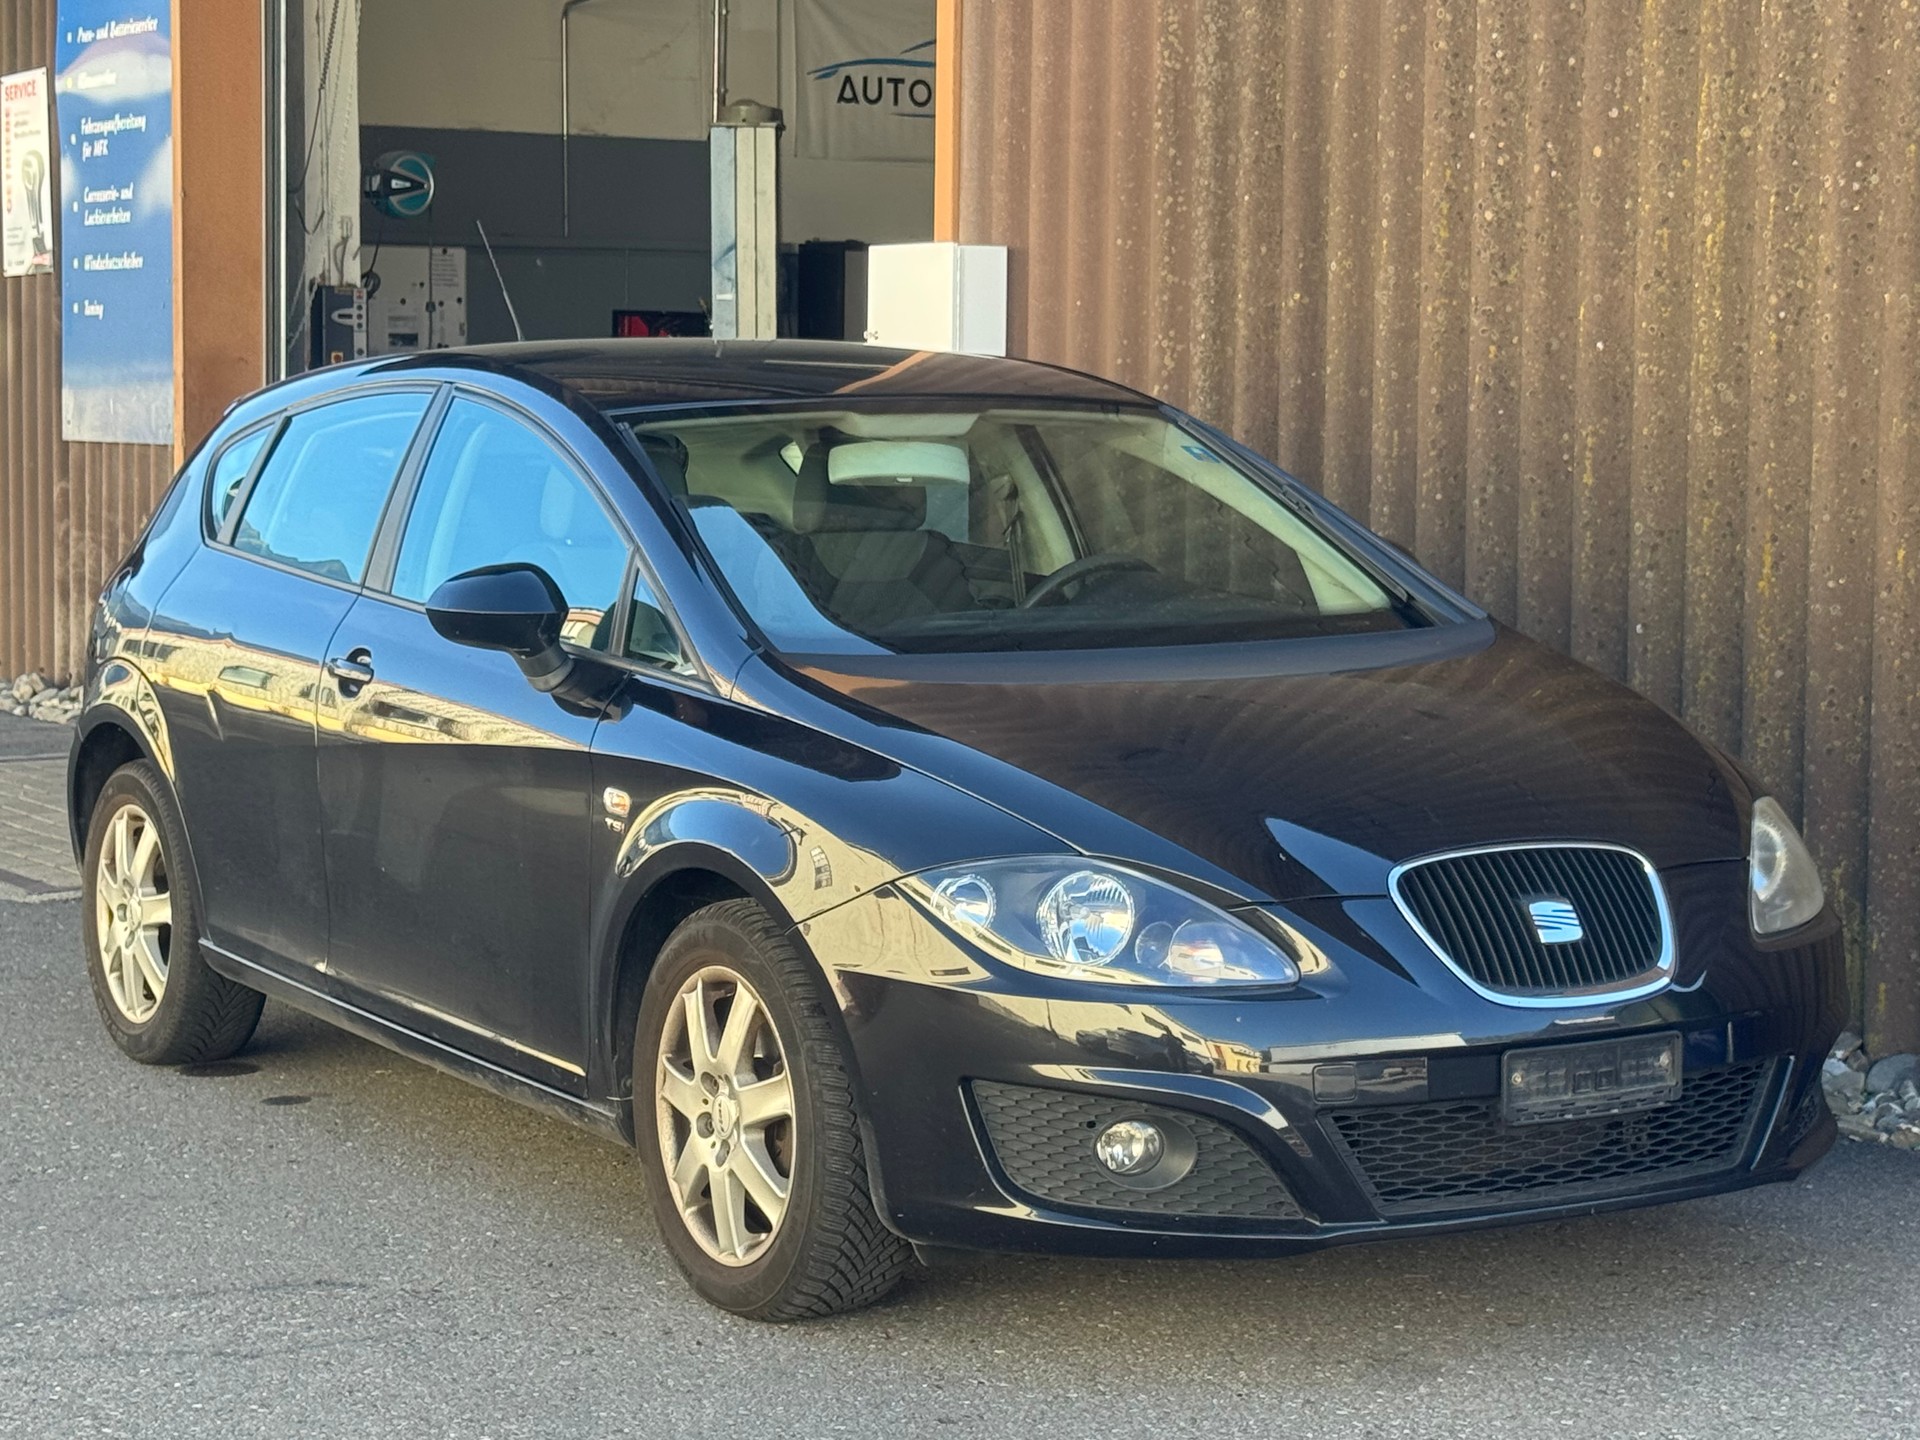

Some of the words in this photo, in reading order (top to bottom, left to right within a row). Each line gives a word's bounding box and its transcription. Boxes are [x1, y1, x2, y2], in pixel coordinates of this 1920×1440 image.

[5, 79, 37, 101] SERVICE
[837, 74, 932, 108] AUTO
[120, 181, 134, 200] und
[84, 206, 131, 226] Lackierarbeiten
[84, 299, 104, 320] Tuning
